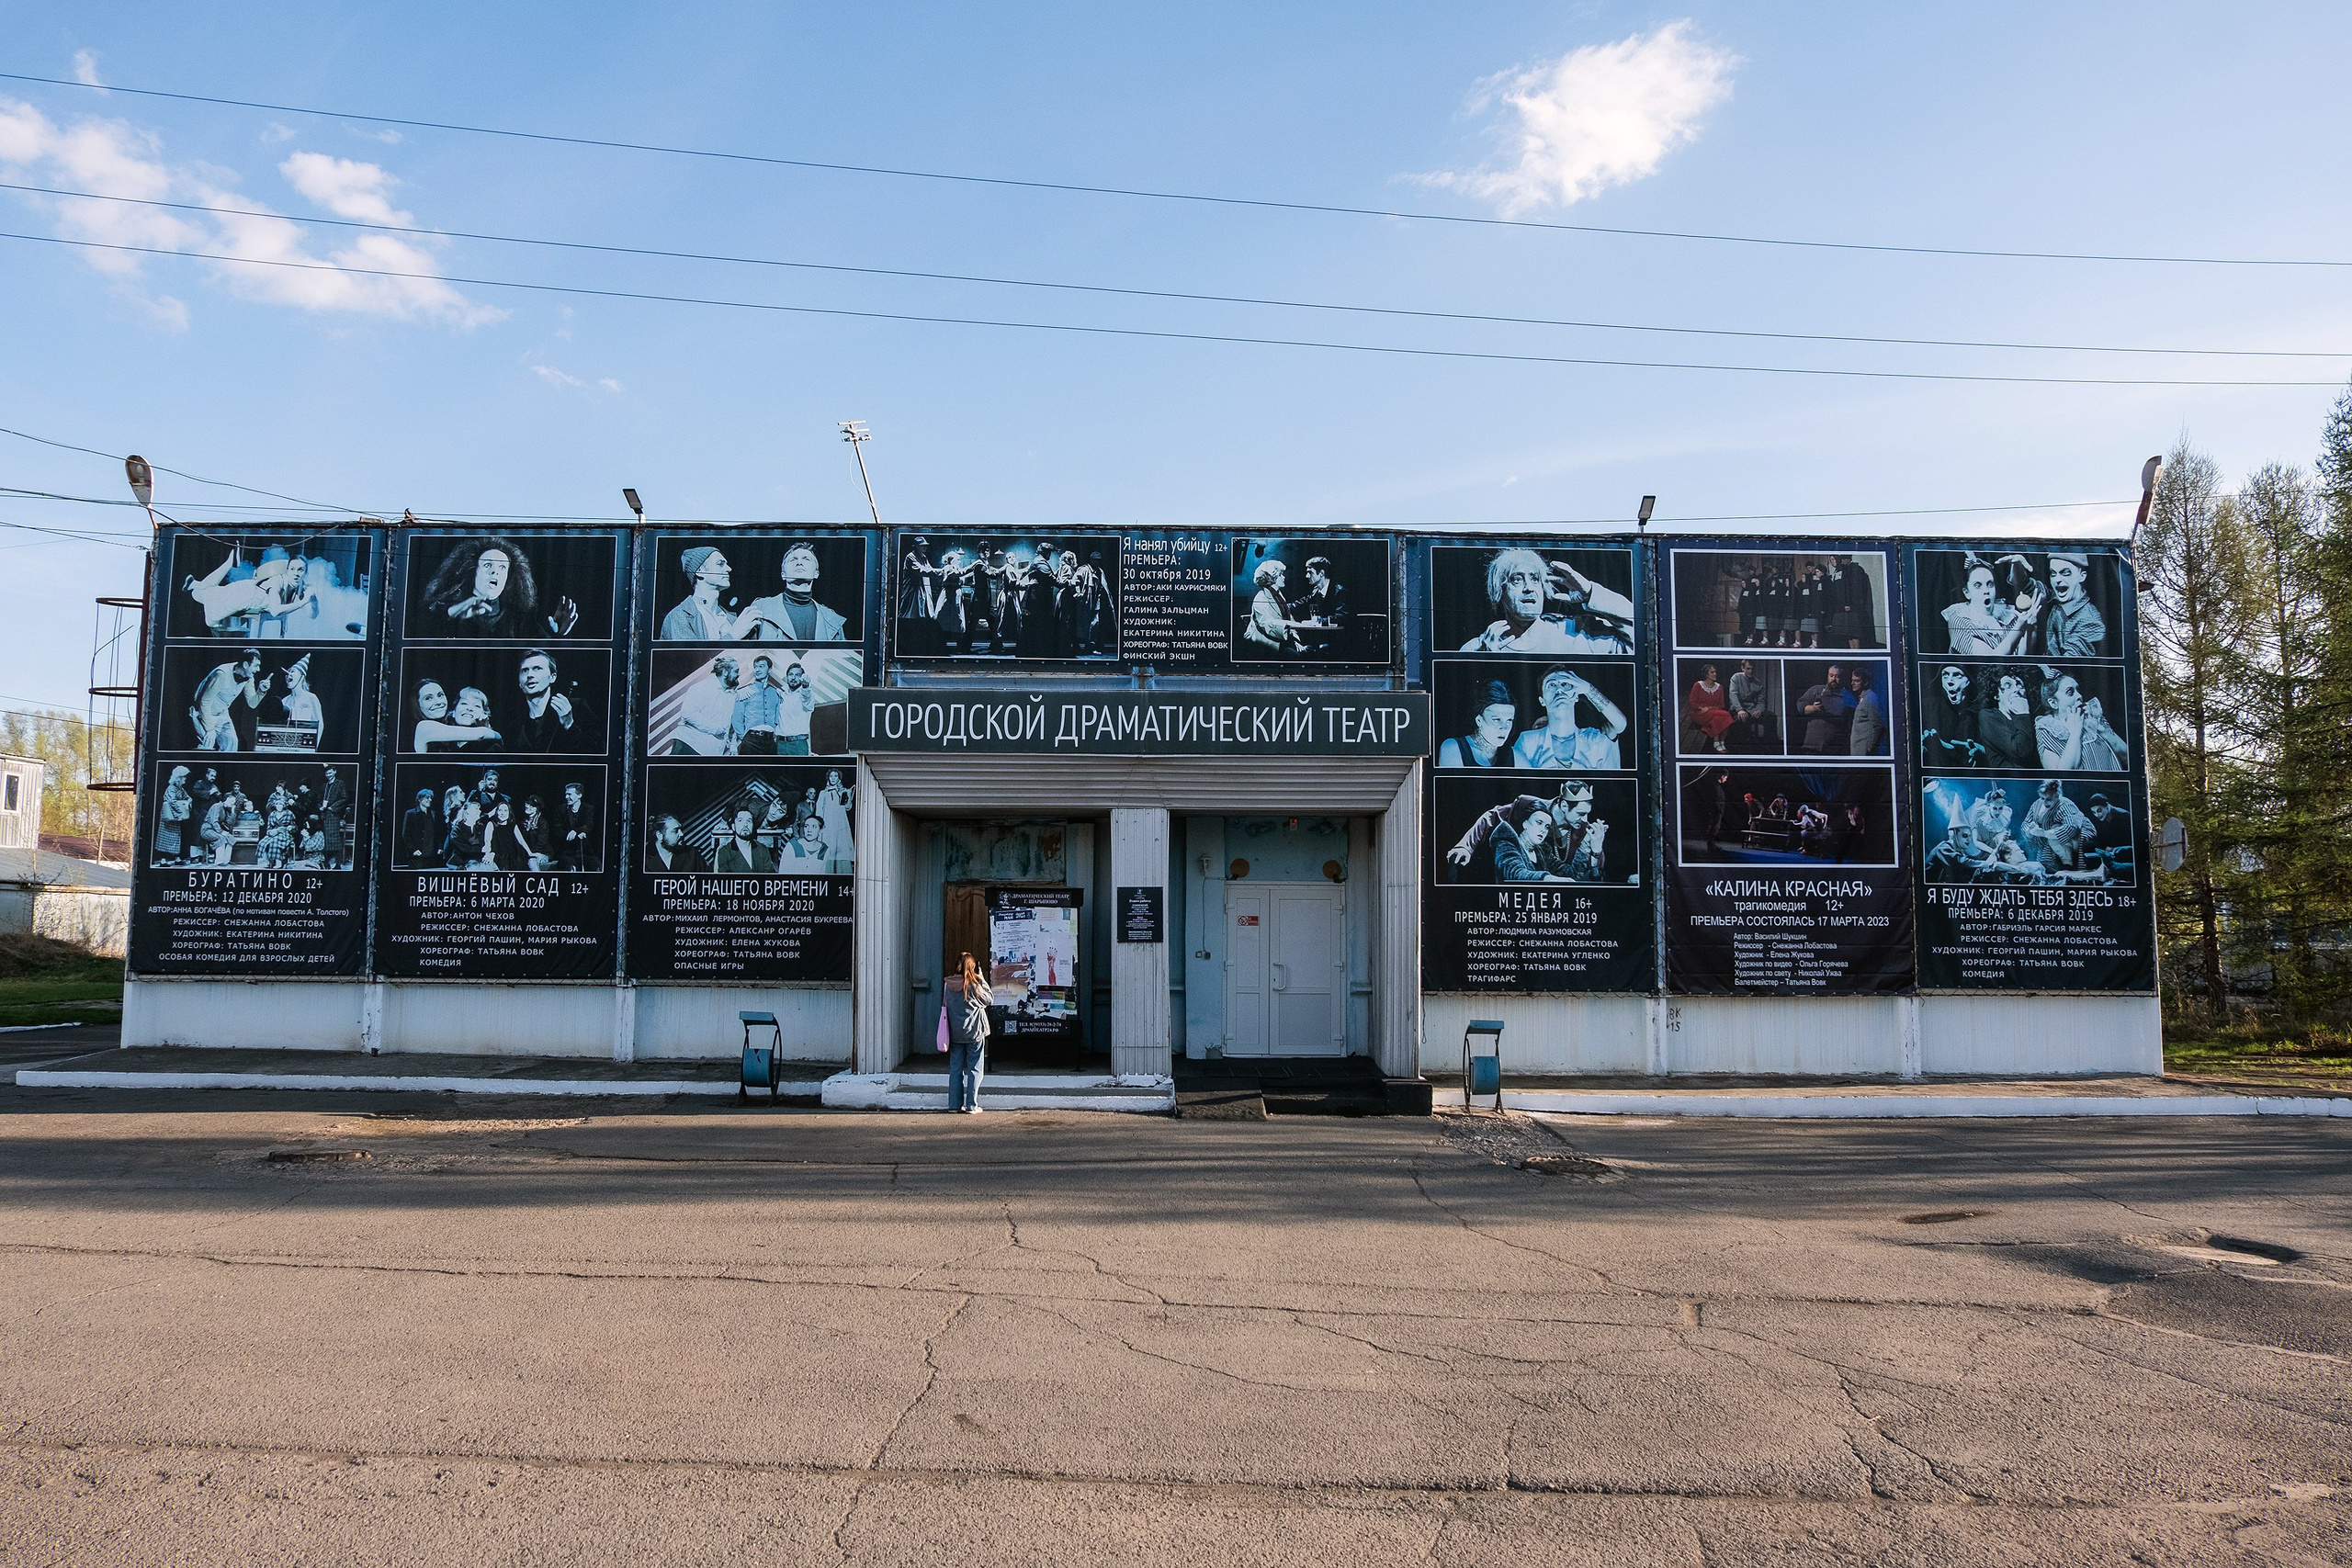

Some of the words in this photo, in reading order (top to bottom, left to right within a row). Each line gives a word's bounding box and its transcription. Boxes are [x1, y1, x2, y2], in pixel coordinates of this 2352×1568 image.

[1124, 537, 1130, 550] Я
[1135, 540, 1167, 550] нанял
[1170, 536, 1210, 555] убийцу
[1124, 554, 1181, 565] ПРЕМЬЕРА:
[1124, 569, 1135, 579] 30
[1140, 569, 1181, 581] октября
[1186, 570, 1210, 580] 2019
[872, 694, 1044, 746] ГОРОДСКОЙ
[1055, 697, 1312, 747] ДРАМАТИЧЕСКИЙ
[1322, 707, 1409, 742] ТЕАТР
[189, 872, 291, 888] БУРАТИНО
[307, 878, 322, 888] 12+
[418, 874, 514, 893] ВИШНЁВЫЙ
[526, 878, 559, 897] САД
[571, 883, 588, 894] 12+
[654, 875, 695, 895] ГЕРОЙ
[702, 880, 759, 896] НАШЕГО
[765, 880, 828, 896] ВРЕМЕНИ
[1706, 881, 1781, 896] «КАЛИНА
[1786, 881, 1871, 897] КРАСНАЯ»
[164, 891, 217, 901] ПРЕМЬЕРА:
[223, 892, 233, 902] 12
[238, 892, 283, 904] ДЕКАБРЯ
[288, 893, 311, 903] 2020
[410, 897, 465, 907] ПРЕМЬЕРА:
[471, 897, 477, 907] 6
[481, 897, 514, 908] МАРТА
[520, 897, 544, 908] 2020
[1499, 893, 1560, 911] МЕДЕЯ
[1576, 898, 1591, 908] 16+
[1928, 888, 1936, 903] Я
[1943, 888, 1974, 907] БУДУ
[1980, 889, 2025, 908] ЖДАТЬ
[2030, 890, 2064, 905] ТЕБЯ
[2069, 891, 2112, 908] ЗДЕСЬ
[2119, 896, 2136, 907] 18+
[663, 899, 720, 909] ПРЕМЬЕРА:
[727, 899, 738, 910] 18
[743, 899, 784, 910] НОЯБРЯ
[789, 900, 814, 910] 2020
[1734, 902, 1806, 913] трагикомедия
[1826, 900, 1844, 910] 12+
[316, 908, 349, 917] Толстого)
[1455, 912, 1510, 922] ПРЕМЬЕРА:
[1516, 912, 1526, 922] 25
[1532, 912, 1568, 922] ЯНВАРЯ
[1574, 912, 1597, 923] 2019
[1949, 908, 2003, 919] ПРЕМЬЕРА:
[2008, 908, 2014, 919] 6
[2018, 909, 2064, 921] ДЕКАБРЯ
[2069, 910, 2093, 920] 2019
[1691, 916, 1744, 925] ПРЕМЬЕРА
[1747, 916, 1815, 926] СОСТОЯЛАСЬ
[1818, 917, 1827, 926] 17
[1831, 917, 1865, 926] МАРТА
[1868, 917, 1889, 926] 2023
[308, 954, 334, 963] ДЕТЕЙ
[2029, 948, 2063, 956] ПАШИН,
